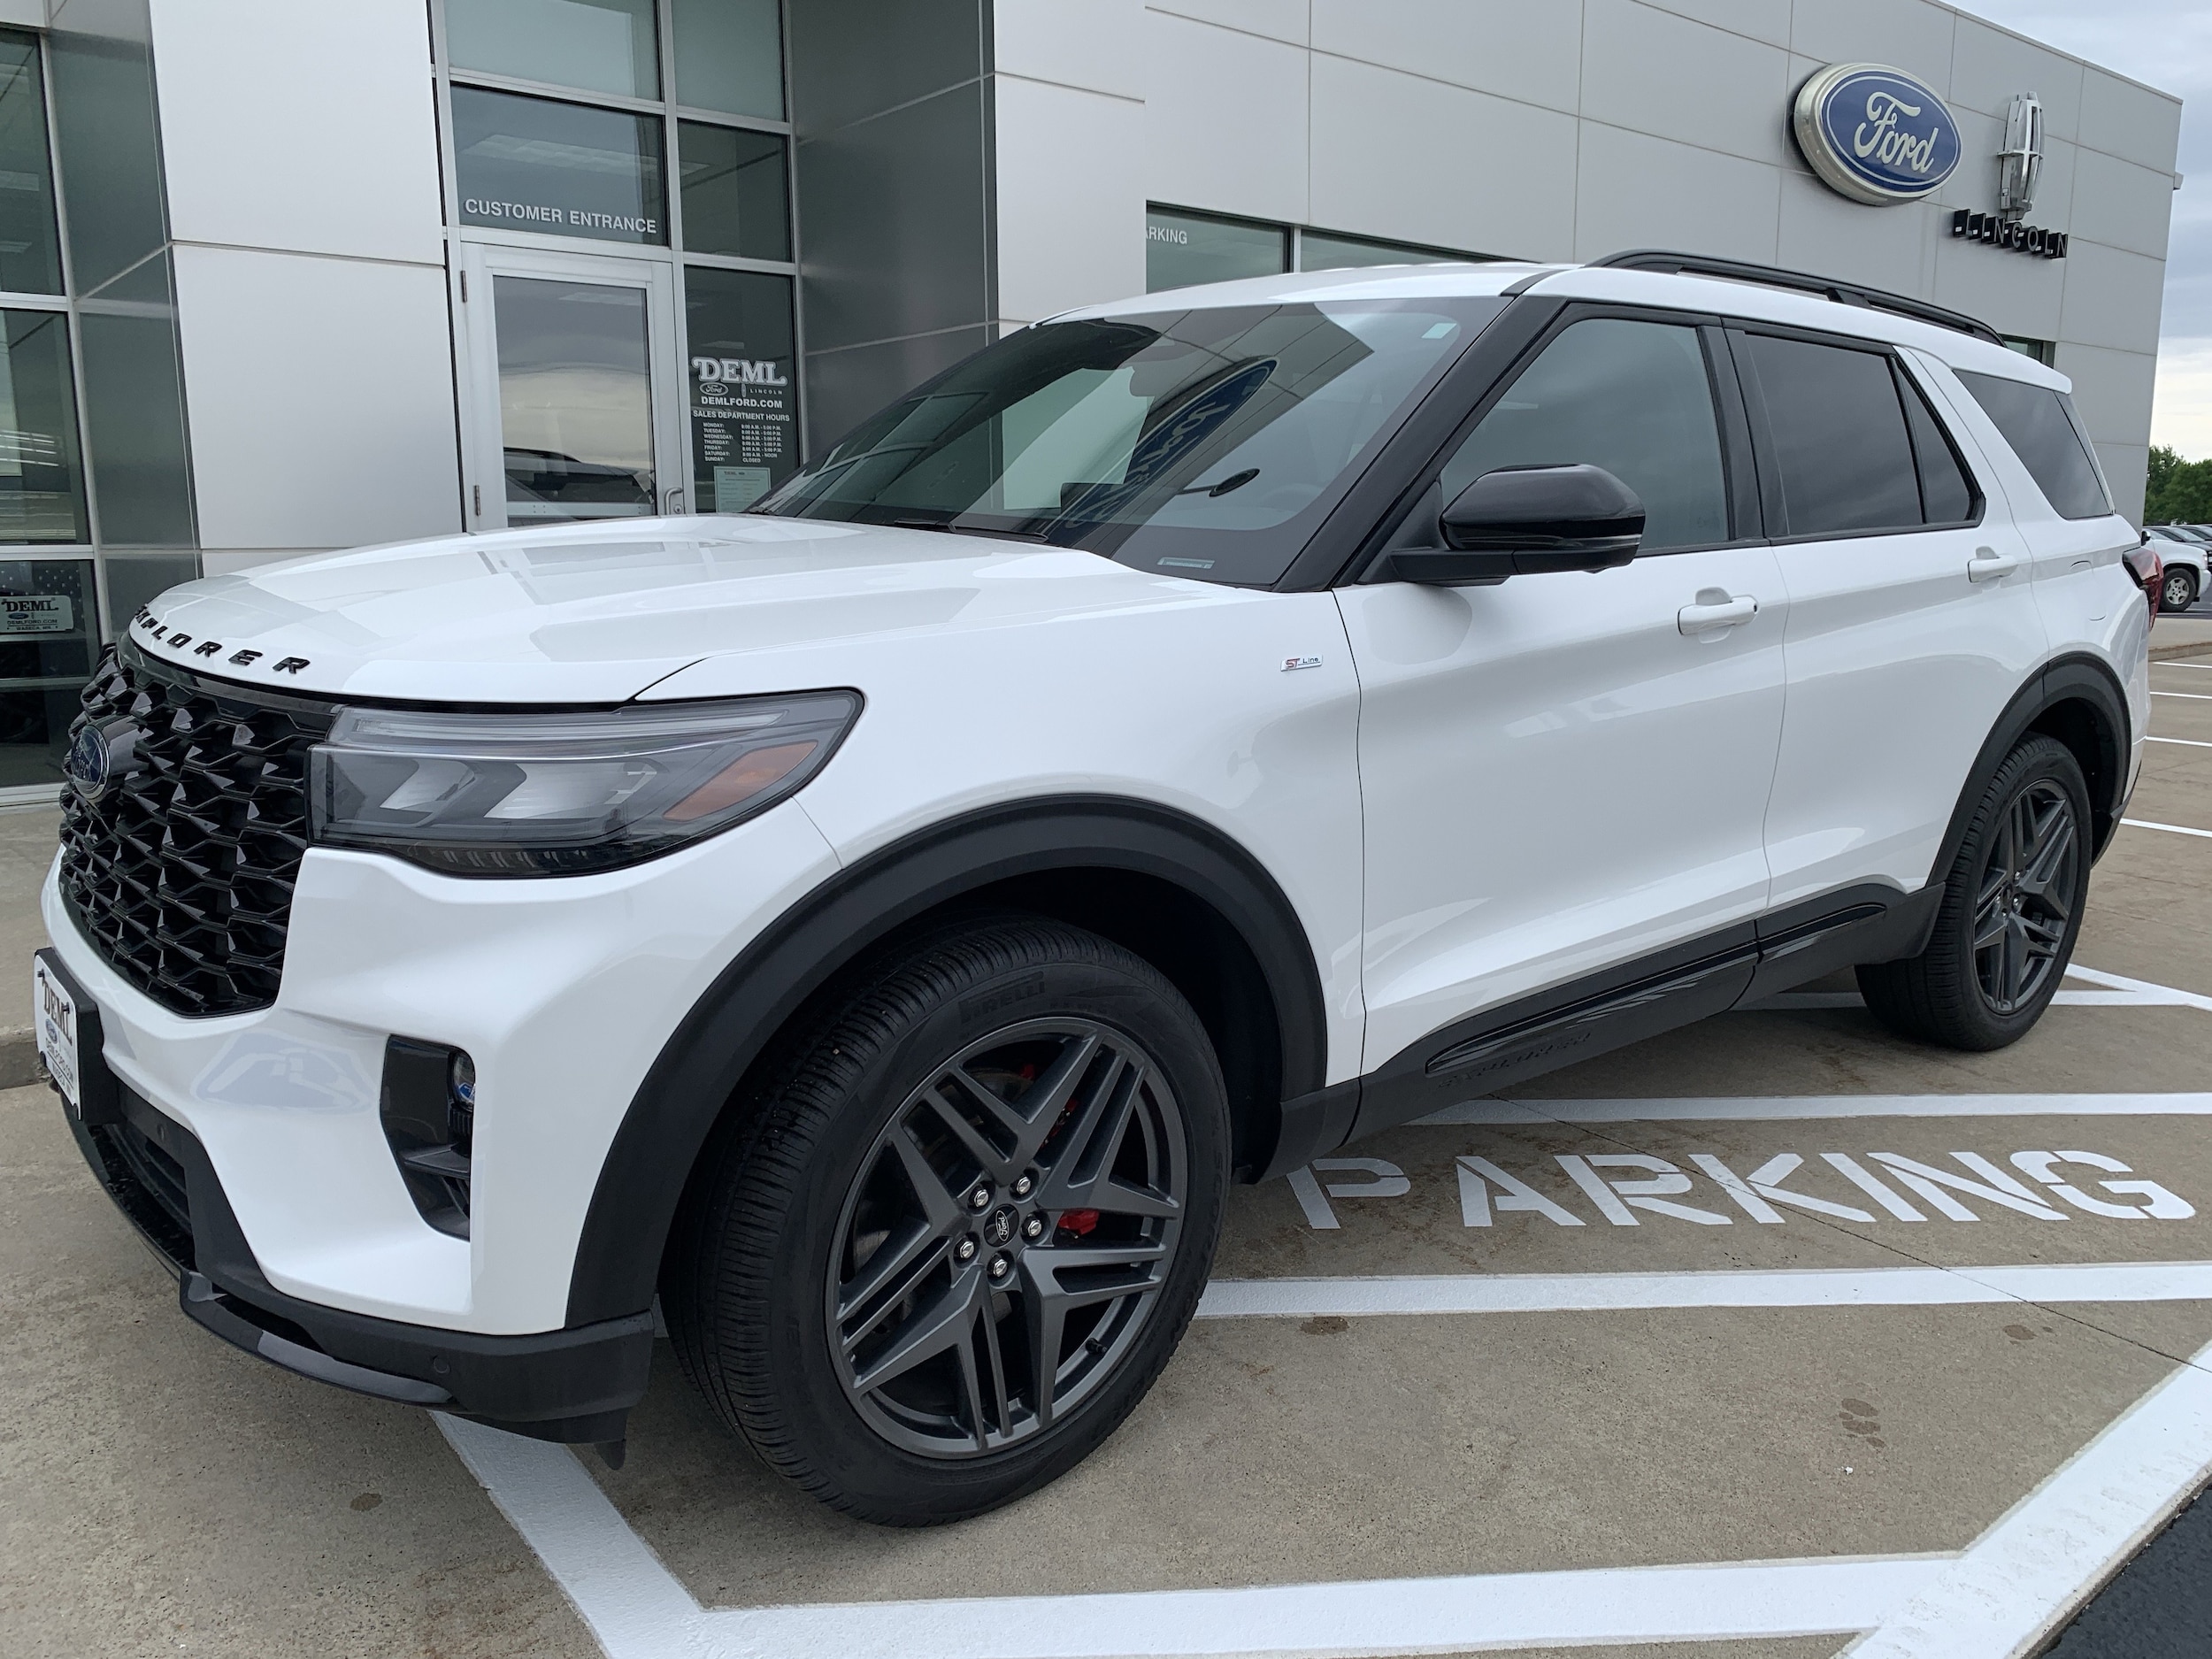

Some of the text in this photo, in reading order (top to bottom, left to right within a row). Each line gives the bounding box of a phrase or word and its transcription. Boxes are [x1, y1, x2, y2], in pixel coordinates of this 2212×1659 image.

[1854, 91, 1939, 174] Ford
[465, 198, 657, 234] CUSTOMER ENTRANCE
[1954, 209, 2069, 260] LINCOLN
[691, 356, 788, 387] DEML
[701, 396, 783, 409] DEMLFORD.COM
[718, 411, 764, 420] DEPARTMENT
[765, 413, 790, 422] HOURS
[2, 600, 59, 612] DEML
[1286, 657, 1301, 669] ST
[1286, 1149, 2196, 1231] PARKING
